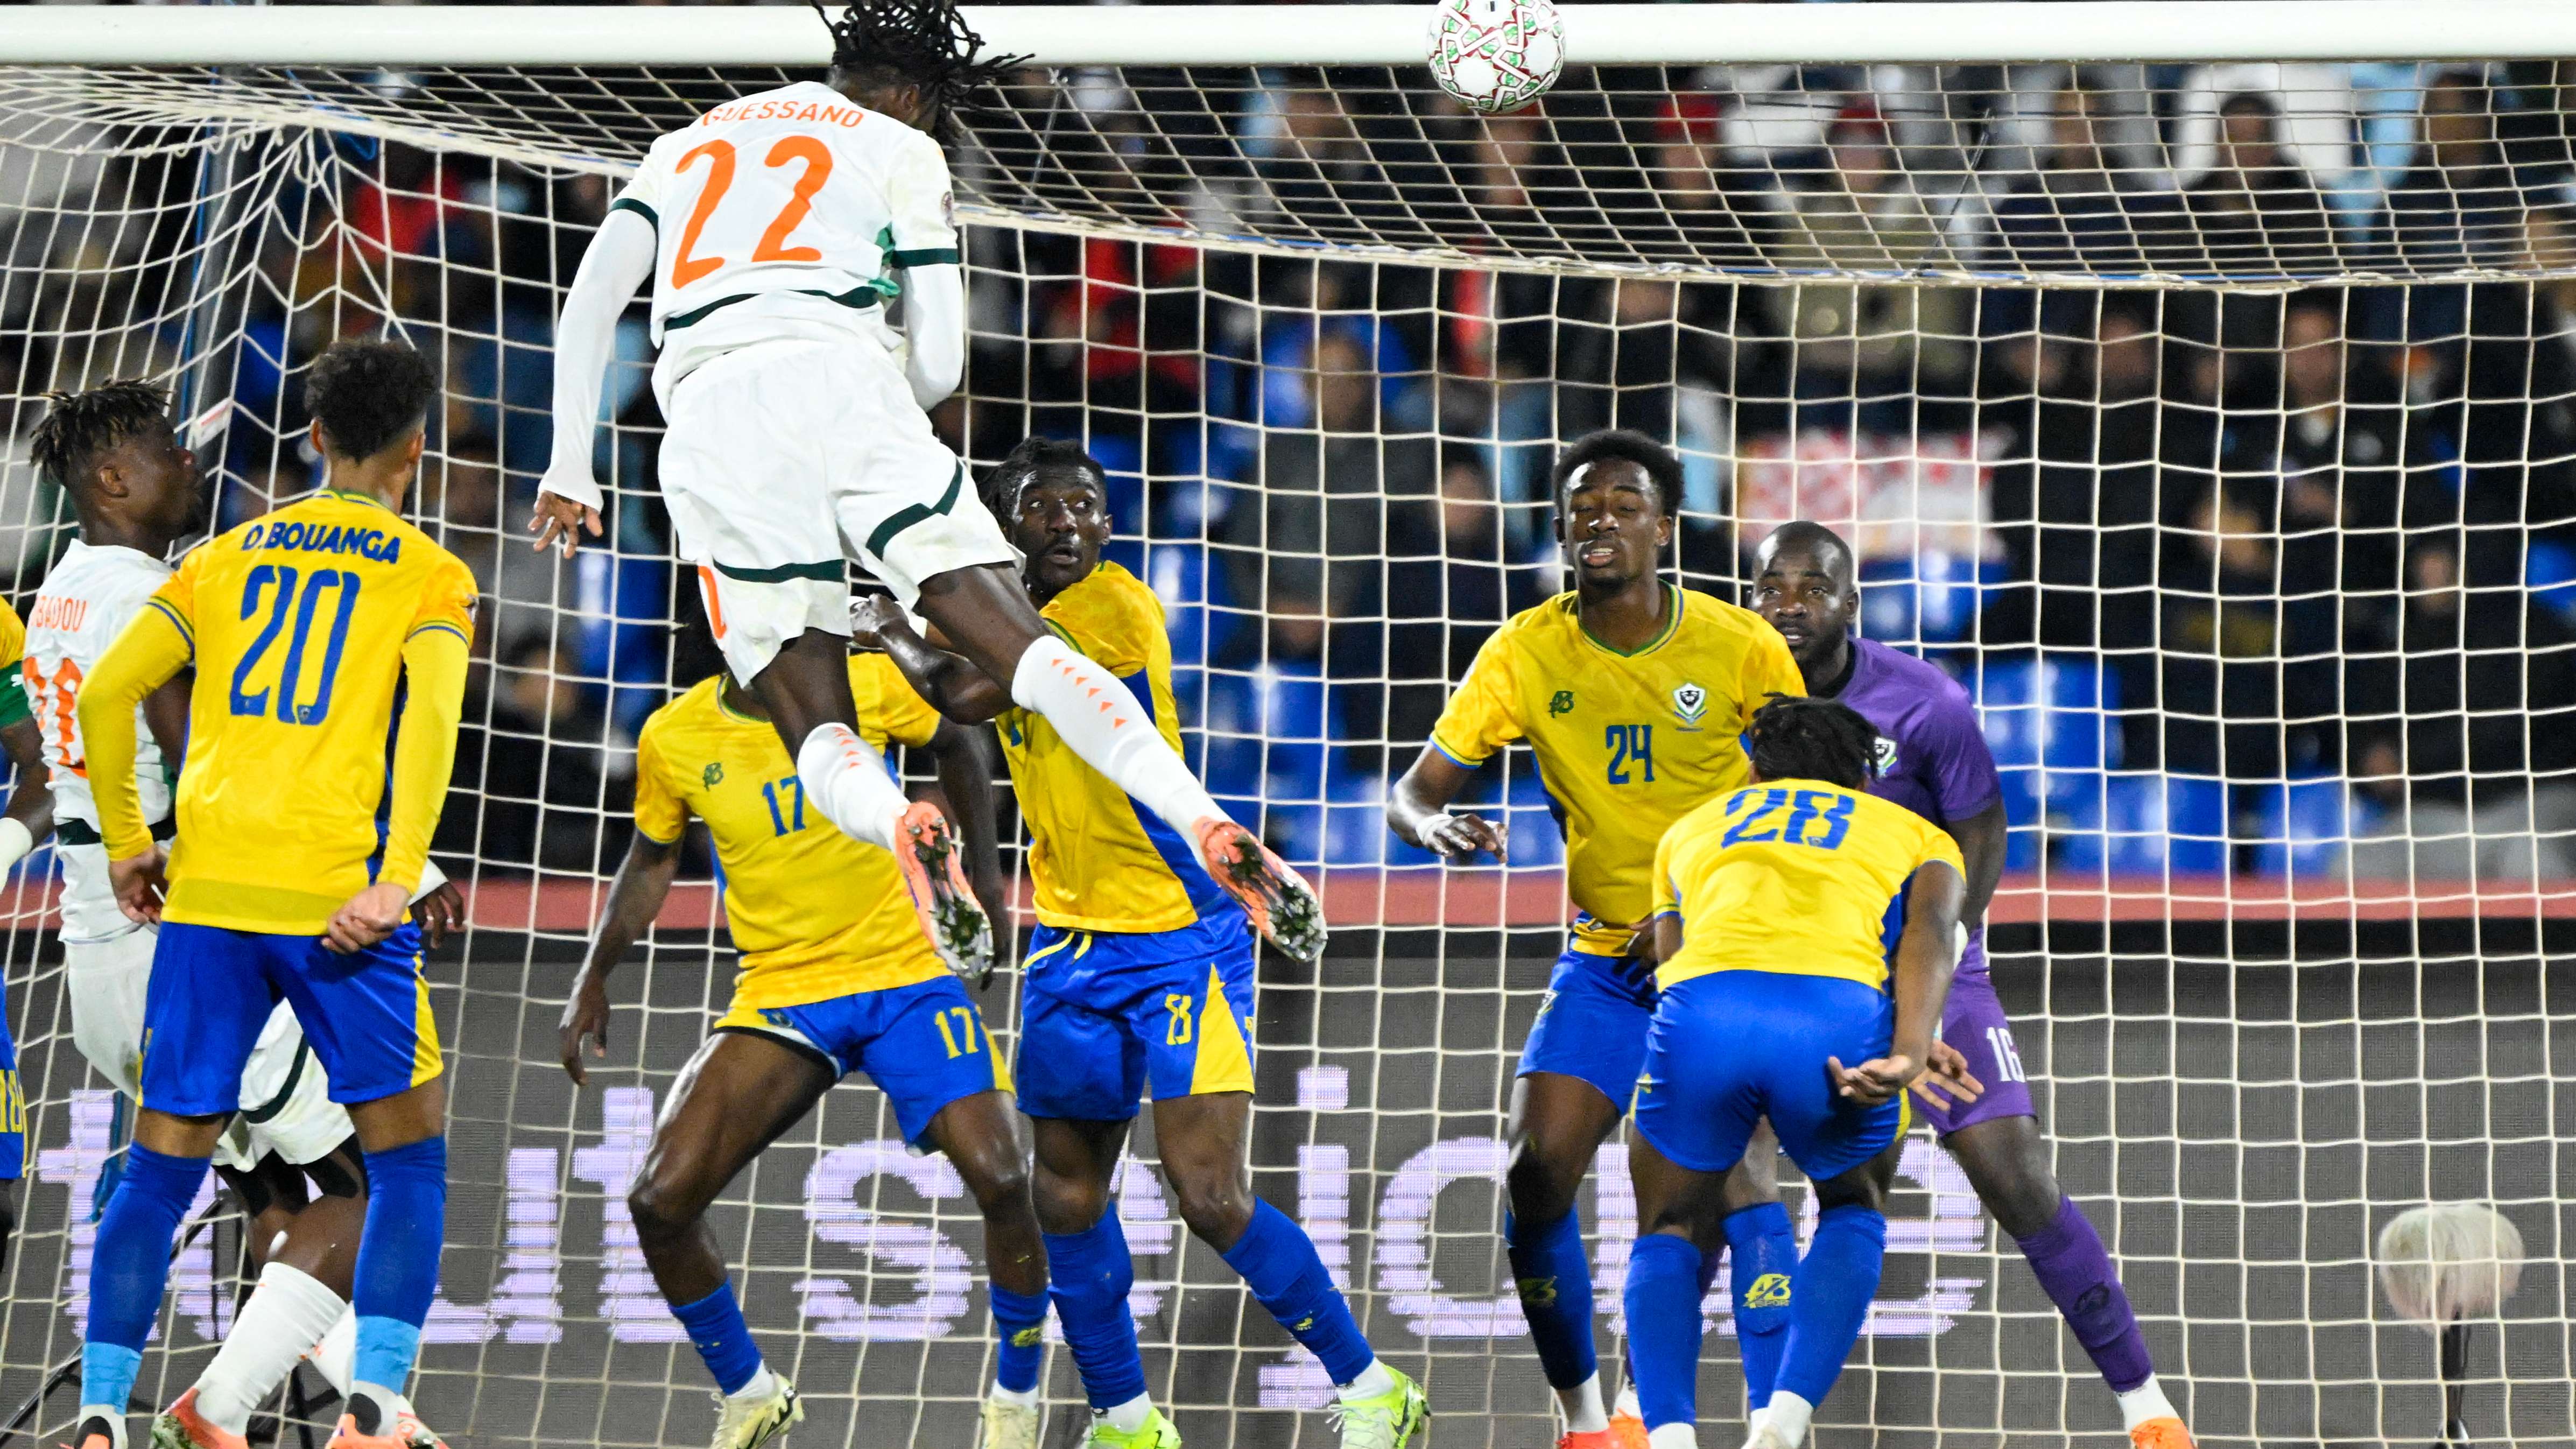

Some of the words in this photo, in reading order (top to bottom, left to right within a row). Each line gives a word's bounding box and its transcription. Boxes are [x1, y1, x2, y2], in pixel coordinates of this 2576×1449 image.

[702, 101, 864, 128] GUESSAND
[672, 136, 833, 290] 22
[241, 522, 401, 564] D.BOUANGA
[230, 565, 361, 726] 20
[1606, 724, 1655, 784] 24
[762, 775, 806, 837] 17
[1721, 789, 1856, 850] 28
[935, 1007, 979, 1059] 17
[1164, 994, 1192, 1045] 8
[1986, 1027, 2025, 1083] 16
